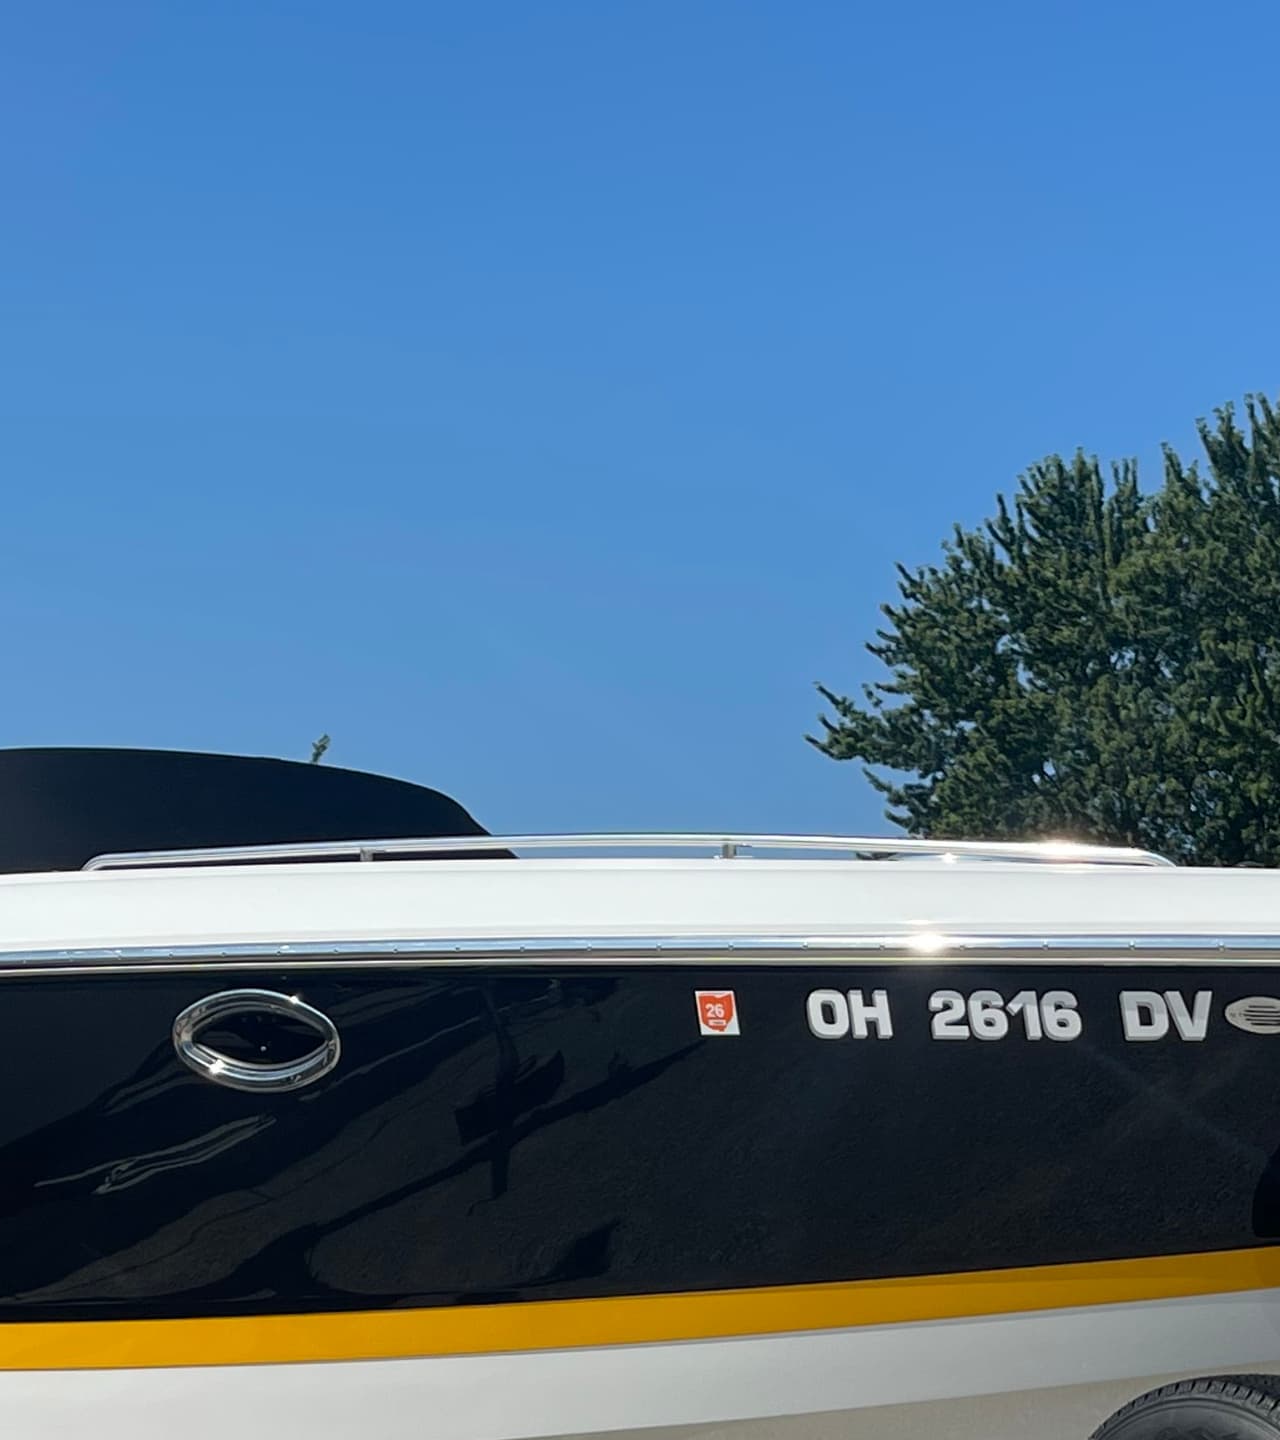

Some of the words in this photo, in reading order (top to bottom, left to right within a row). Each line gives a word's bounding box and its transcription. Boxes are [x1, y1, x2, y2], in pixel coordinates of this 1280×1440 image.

[705, 1003, 725, 1018] 26
[807, 989, 894, 1039] OH
[928, 989, 1083, 1041] 2616
[1119, 990, 1213, 1041] DV
